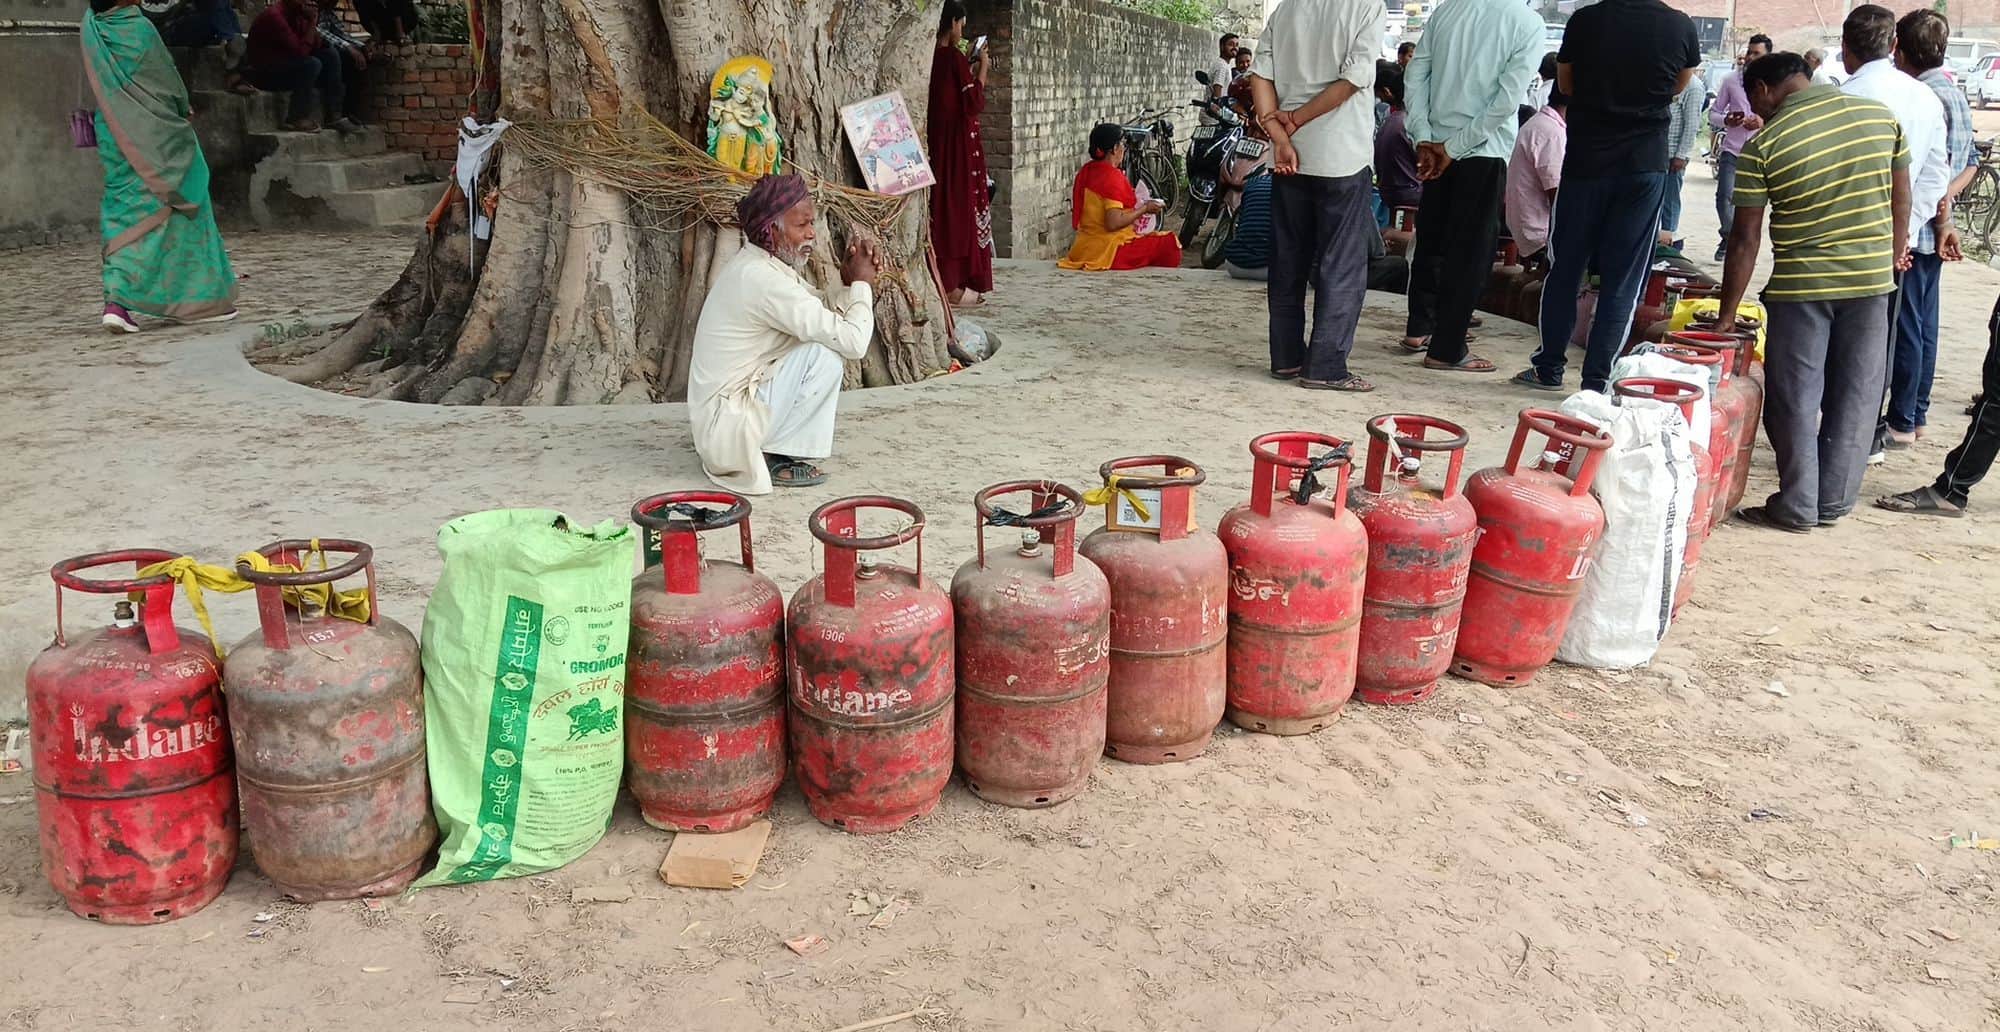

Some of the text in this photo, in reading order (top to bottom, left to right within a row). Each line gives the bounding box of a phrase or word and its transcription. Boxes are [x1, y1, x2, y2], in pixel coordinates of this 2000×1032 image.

[1558, 441, 1573, 462] 15.5
[308, 629, 336, 643] 15.7
[820, 629, 846, 643] 1906
[570, 652, 624, 674] GROMOR
